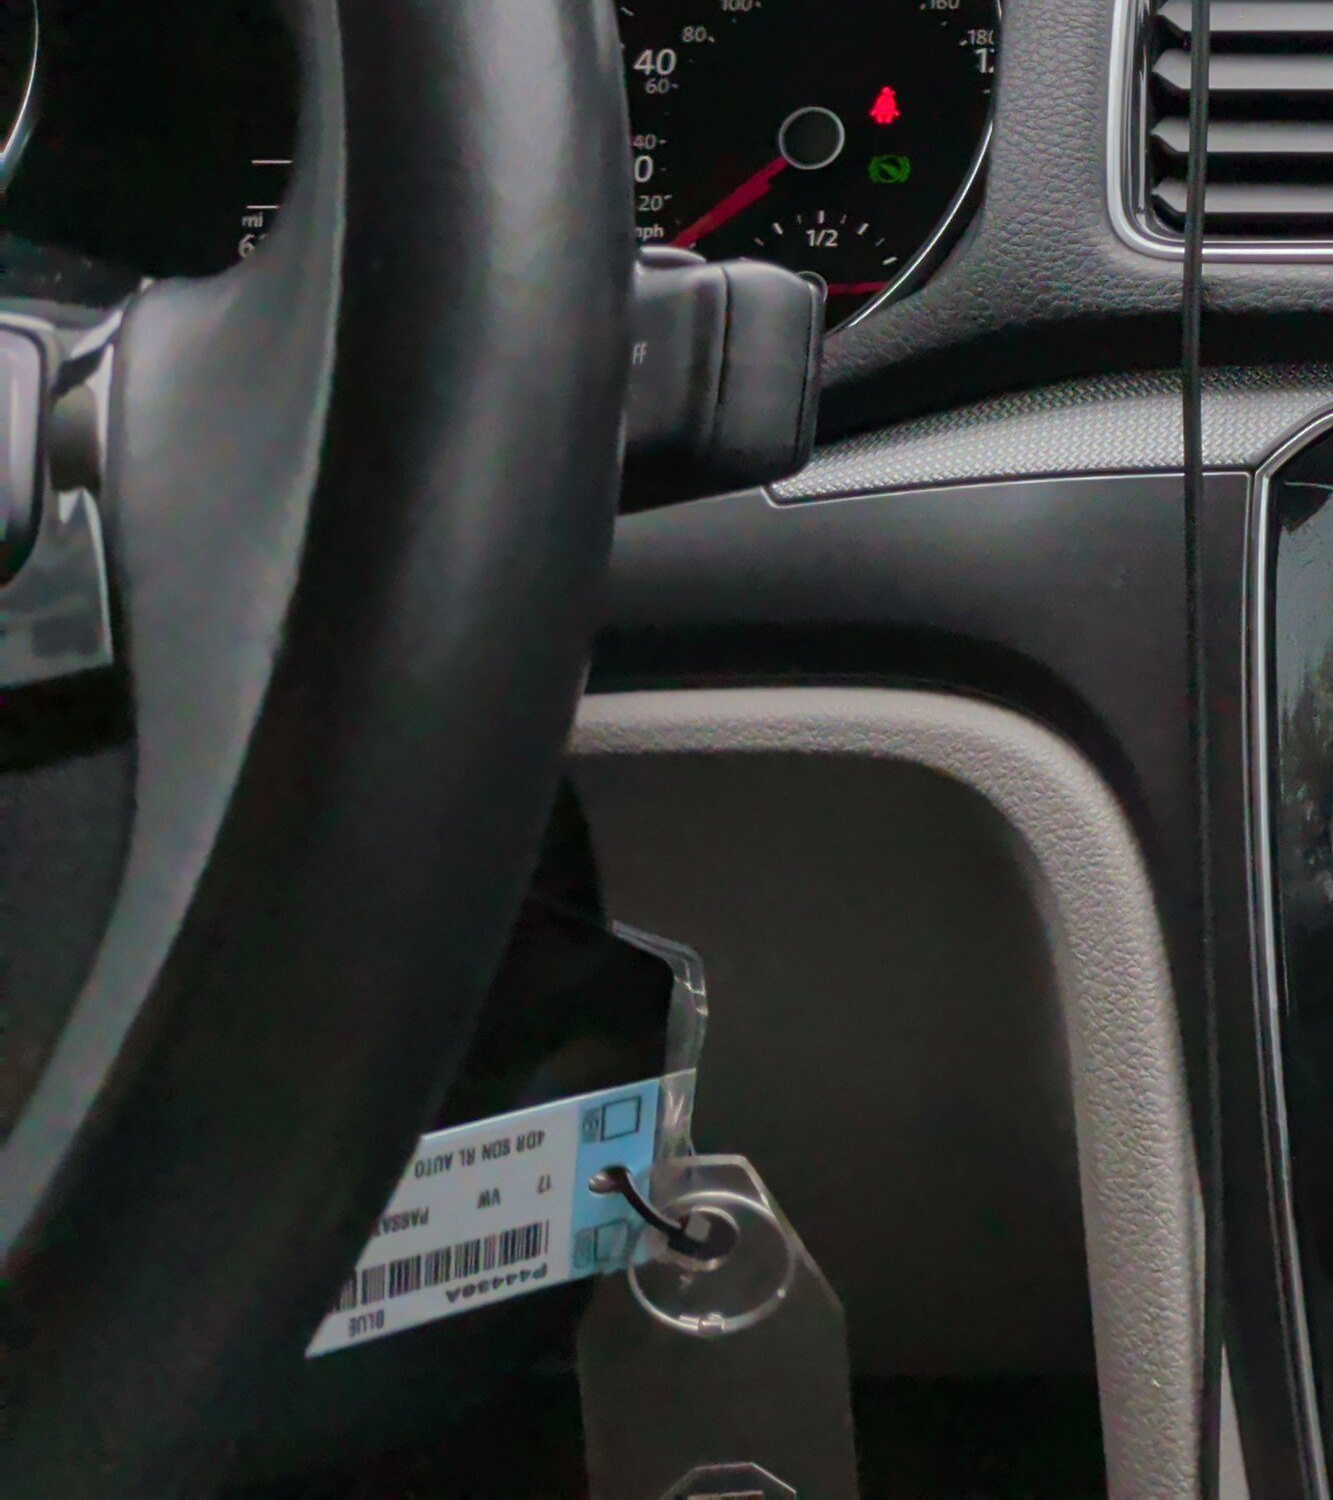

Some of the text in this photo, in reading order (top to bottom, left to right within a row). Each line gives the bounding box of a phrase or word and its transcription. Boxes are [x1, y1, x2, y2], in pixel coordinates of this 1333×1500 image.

[681, 26, 707, 43] 80
[633, 48, 677, 76] 40
[645, 78, 669, 94] 60
[633, 155, 654, 183] 0
[638, 195, 664, 211] 20
[241, 211, 264, 228] mi
[806, 229, 839, 247] 1/2
[414, 1129, 546, 1179] 4DR SDN RL AUTO
[537, 1174, 552, 1195] 17
[477, 1187, 501, 1210] VW
[348, 1309, 386, 1338] BLUE
